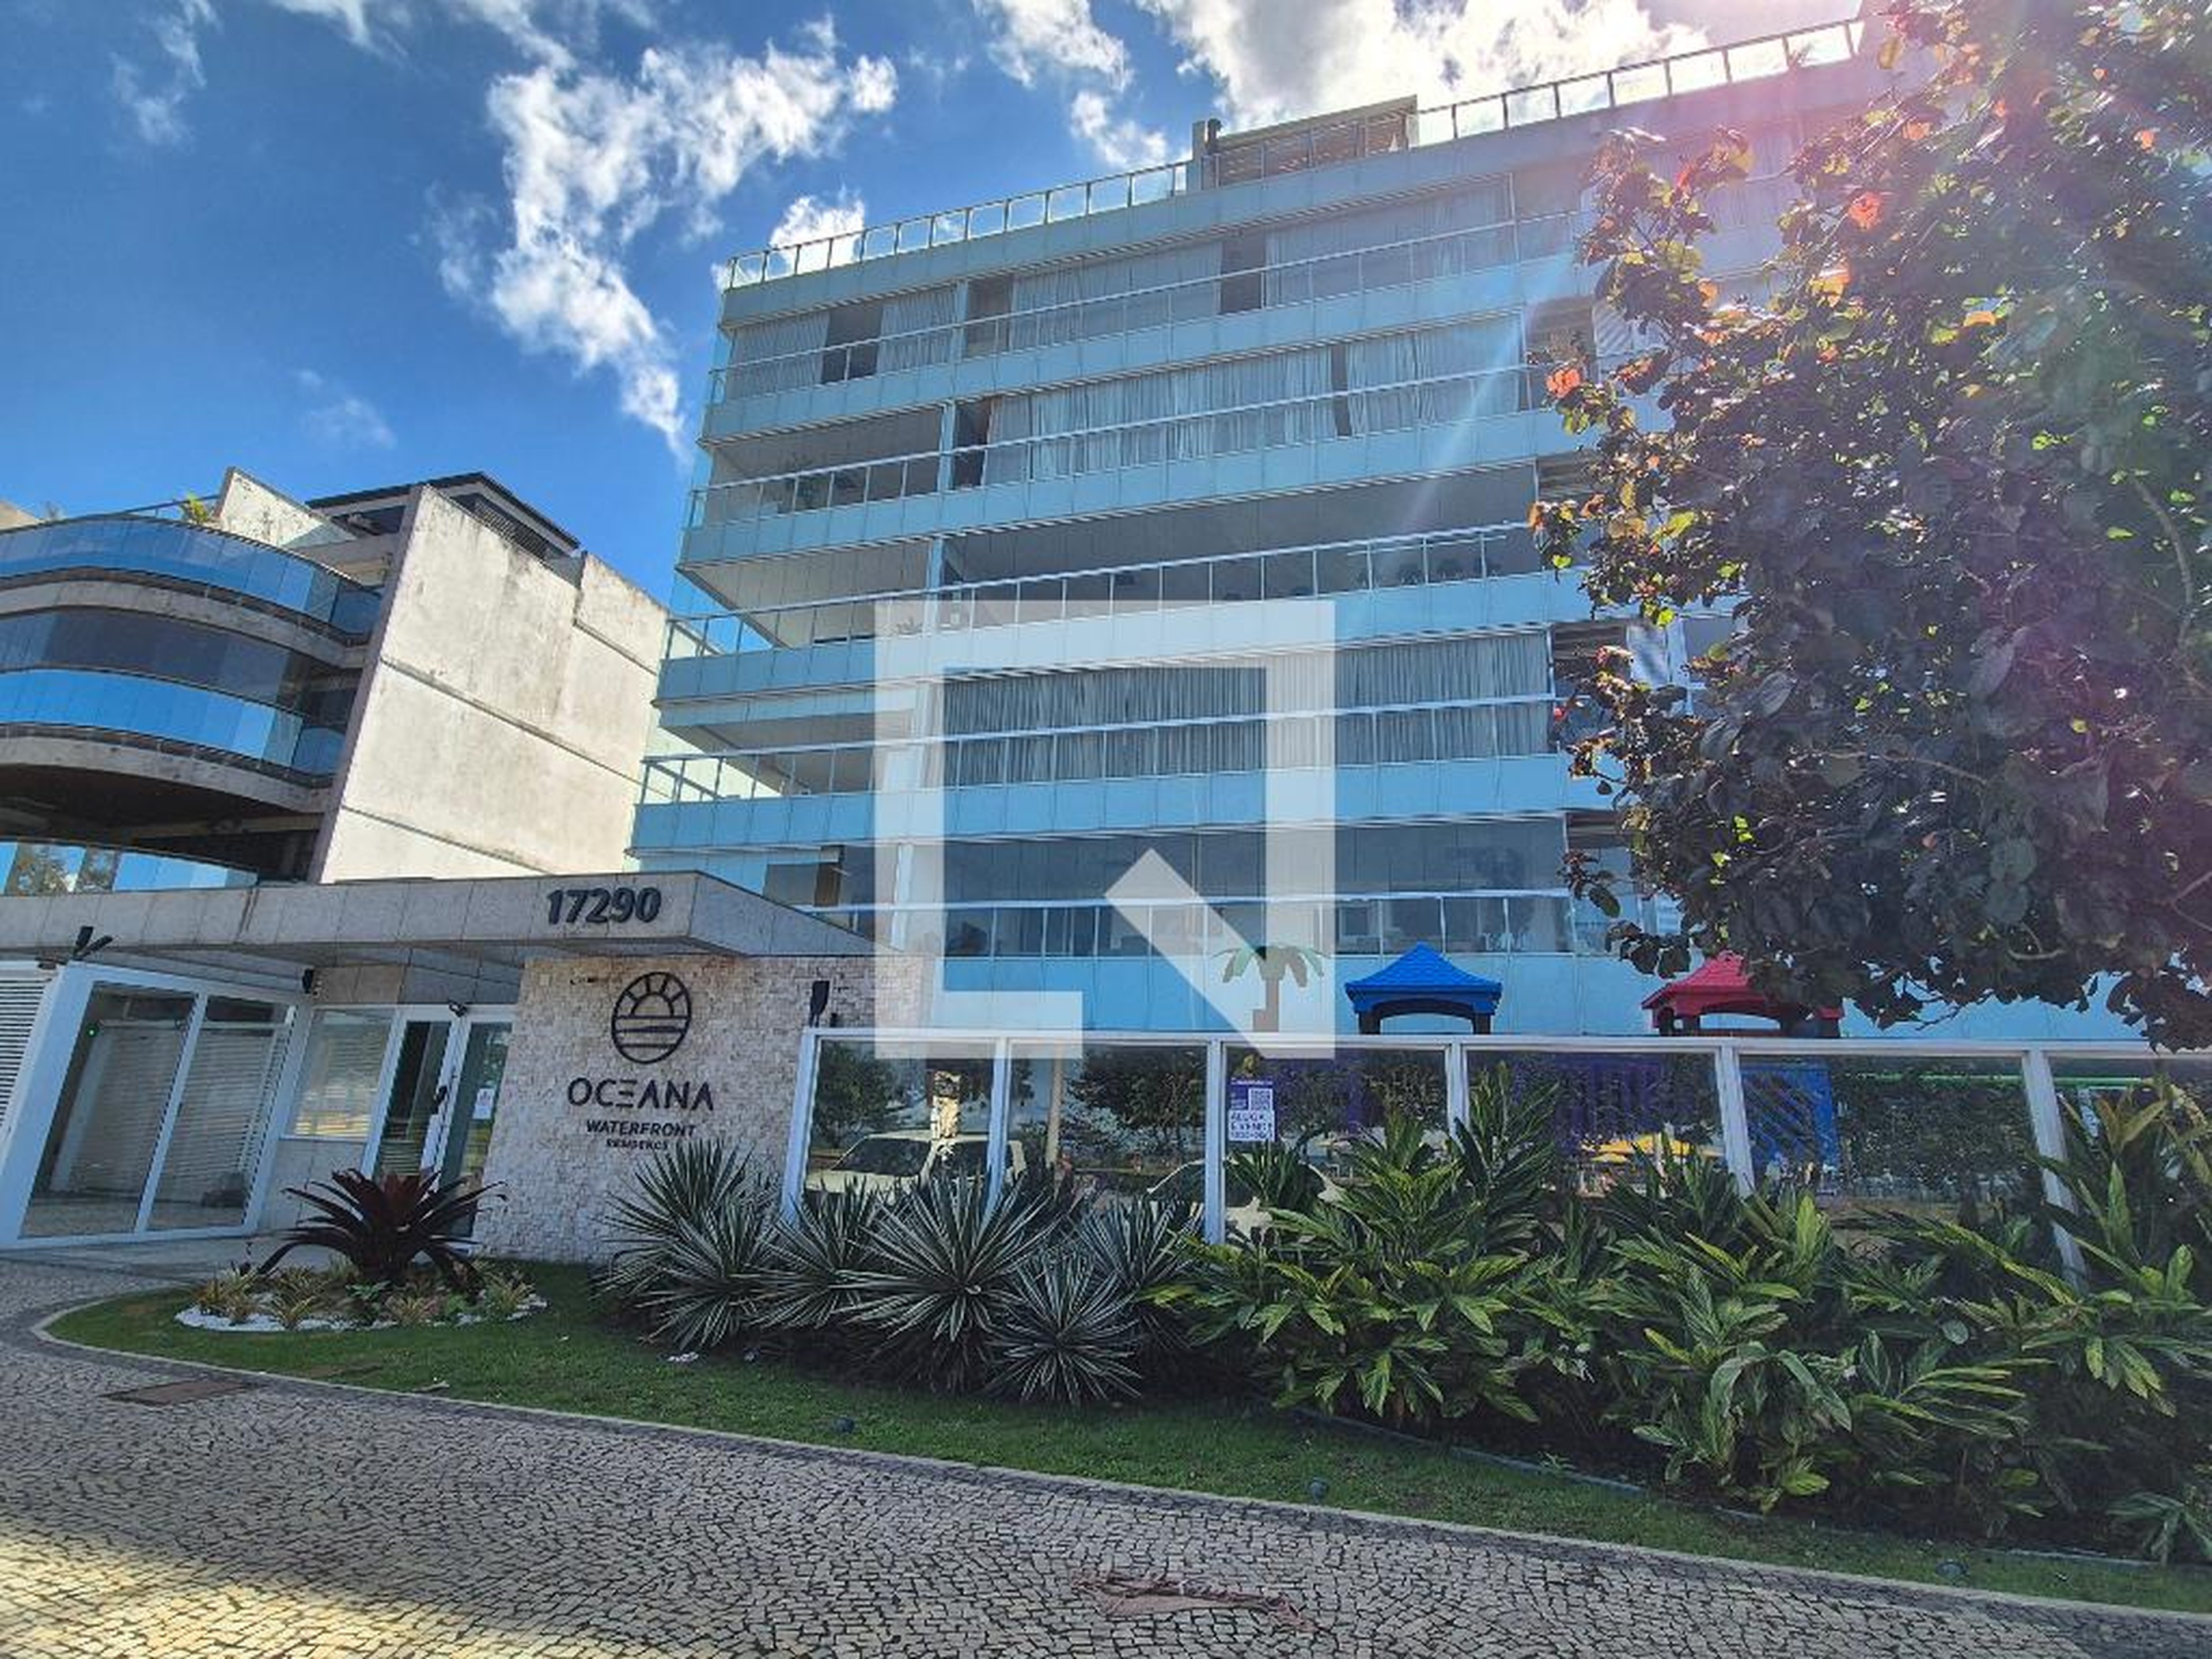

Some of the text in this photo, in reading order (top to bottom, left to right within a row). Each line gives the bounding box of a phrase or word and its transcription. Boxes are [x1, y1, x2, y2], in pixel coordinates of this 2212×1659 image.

[547, 888, 661, 924] 17290
[567, 1077, 714, 1111] OCEANA
[586, 1120, 696, 1137] WATERFRONT
